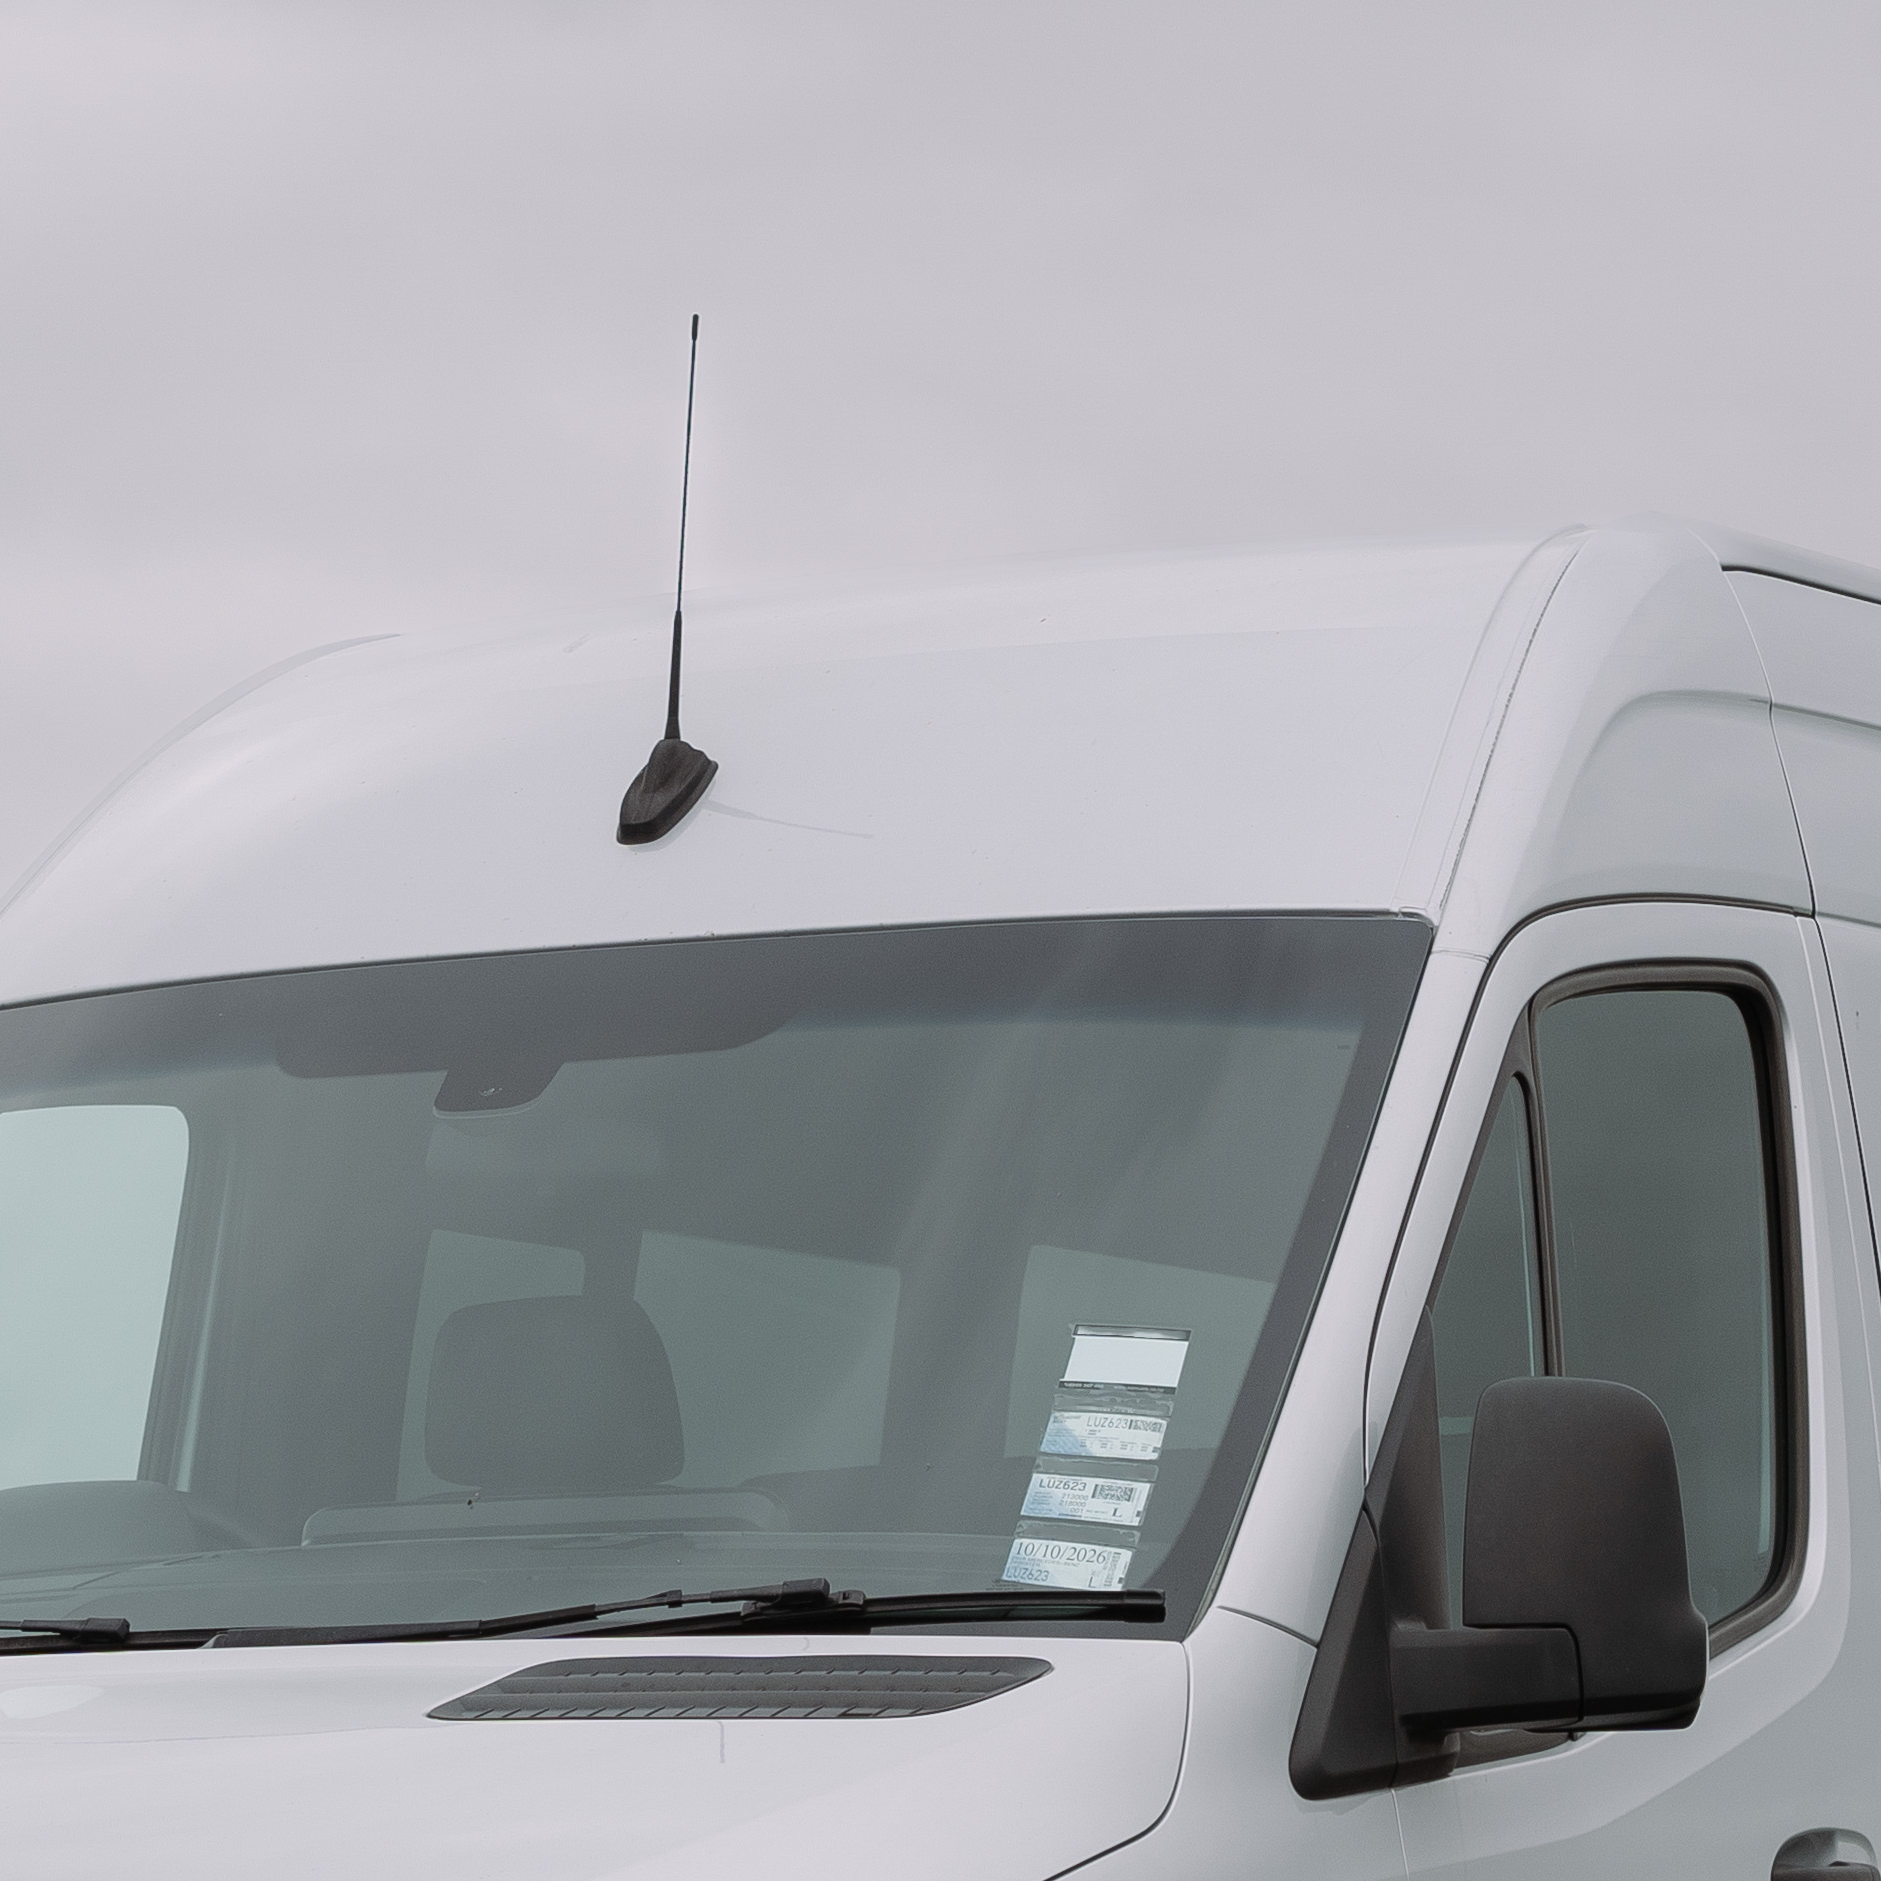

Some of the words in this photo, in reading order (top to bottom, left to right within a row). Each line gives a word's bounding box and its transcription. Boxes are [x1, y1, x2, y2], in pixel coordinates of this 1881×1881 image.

[1086, 1416, 1129, 1429] LUZ623
[1038, 1478, 1087, 1491] LUZ623
[1112, 1508, 1122, 1518] L
[1016, 1541, 1107, 1565] 10/10/2026
[1005, 1567, 1050, 1582] LUZ623
[1088, 1576, 1097, 1588] L
